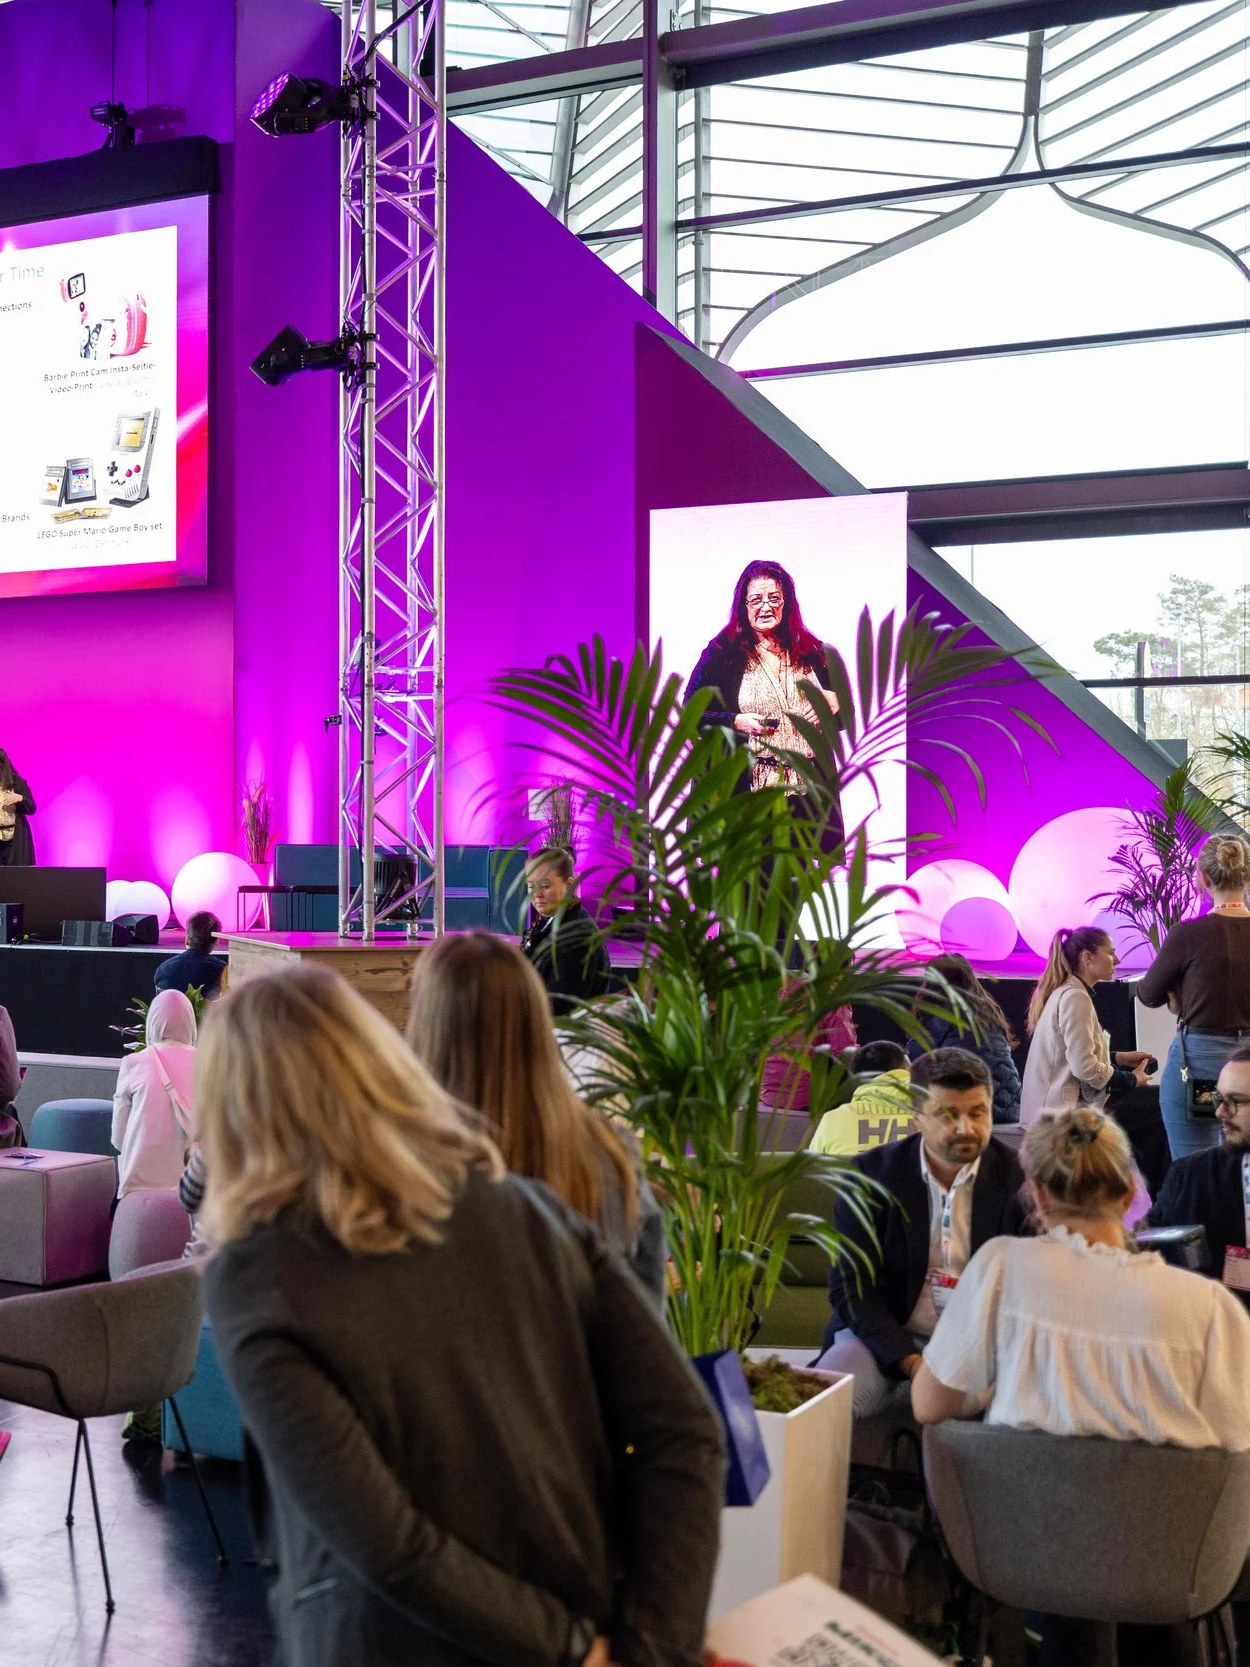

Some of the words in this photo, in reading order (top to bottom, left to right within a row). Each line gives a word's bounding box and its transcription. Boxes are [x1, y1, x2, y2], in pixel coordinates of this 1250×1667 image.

[9, 264, 45, 281] Time
[44, 372, 69, 382] Barbie
[70, 370, 89, 379] Print
[90, 367, 108, 377] Cam
[50, 382, 93, 394] Video-Print
[1, 513, 30, 523] Brands
[38, 529, 58, 539] LEGO
[59, 528, 81, 538] Super
[83, 526, 106, 535] Mario
[108, 525, 131, 533] Game
[133, 522, 149, 532] Boy
[150, 521, 163, 530] set
